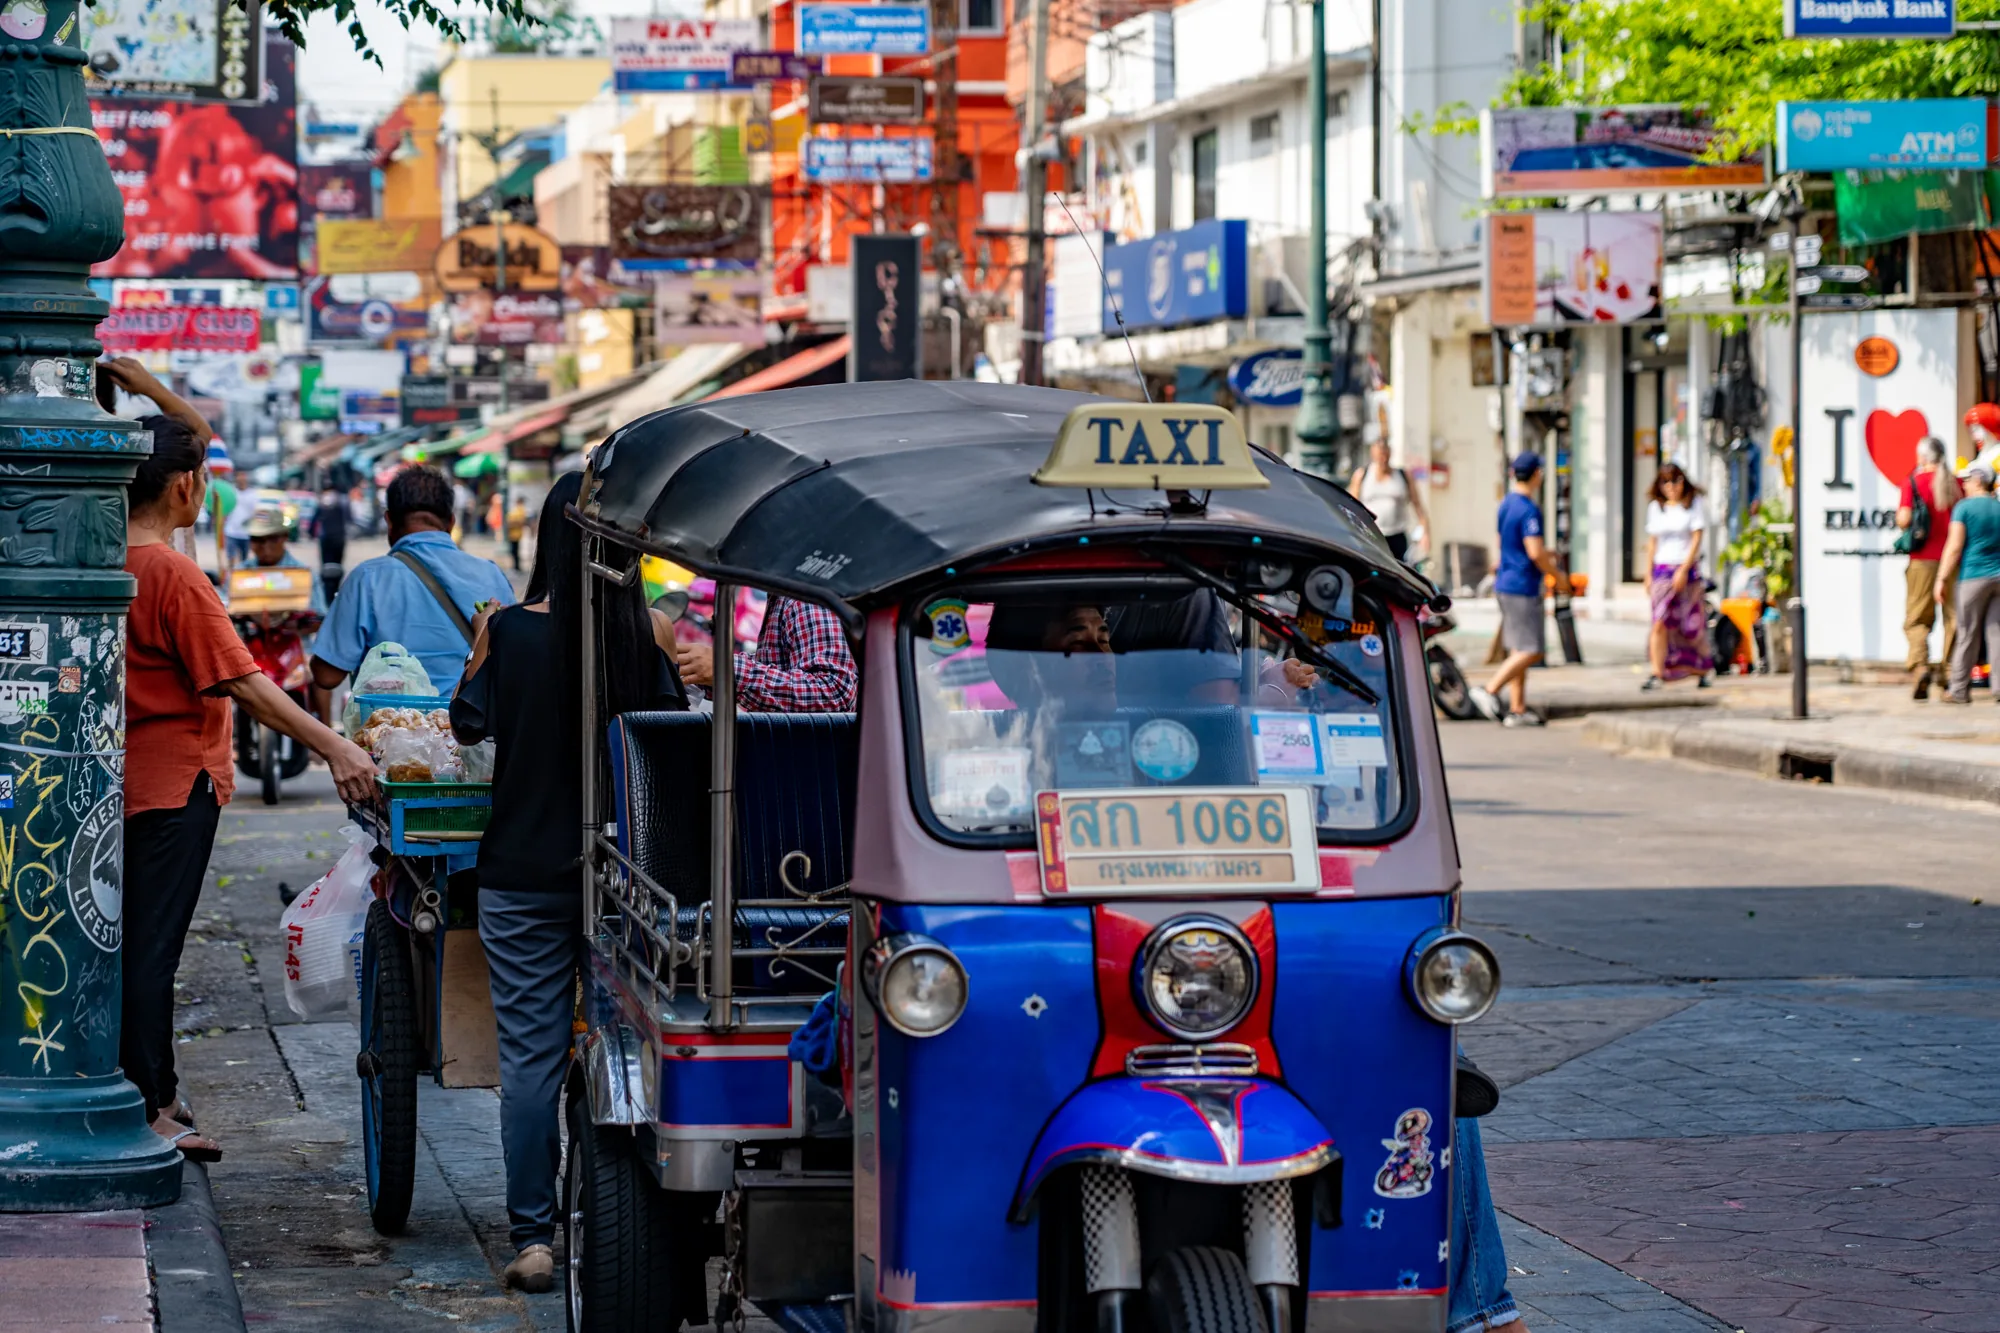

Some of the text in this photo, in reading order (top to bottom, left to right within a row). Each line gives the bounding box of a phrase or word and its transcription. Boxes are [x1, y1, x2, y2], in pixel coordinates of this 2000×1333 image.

[1801, 0, 1947, 23] Bangkok Bank
[647, 21, 716, 39] NAT
[1901, 132, 1956, 152] ATM
[100, 311, 254, 332] OMEDY CLUB
[1245, 357, 1304, 397] Boo
[1087, 418, 1224, 466] TAXI
[1824, 409, 1855, 489] I
[1282, 733, 1311, 746] 2563
[84, 797, 119, 839] WEST
[1067, 798, 1141, 847] สก
[1166, 799, 1285, 845] 1066
[1099, 859, 1263, 885] กรุงเทพมหานคร
[285, 922, 303, 982] JT-45
